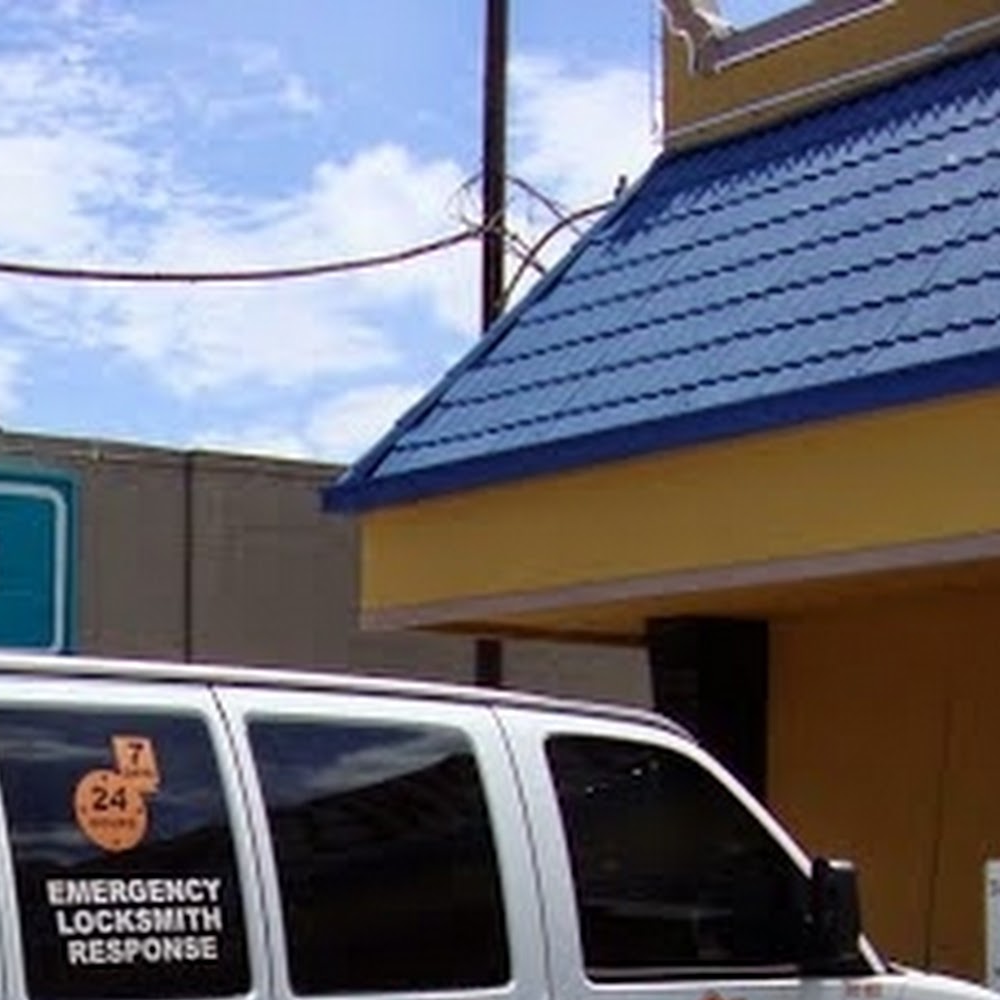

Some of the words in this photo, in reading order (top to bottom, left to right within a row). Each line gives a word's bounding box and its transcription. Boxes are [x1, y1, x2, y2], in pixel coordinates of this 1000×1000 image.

[128, 742, 144, 766] 7
[90, 786, 129, 812] 24
[46, 877, 222, 906] EMERGENCY
[56, 905, 223, 936] LOCKSMITH
[66, 935, 219, 966] RESPONSE
